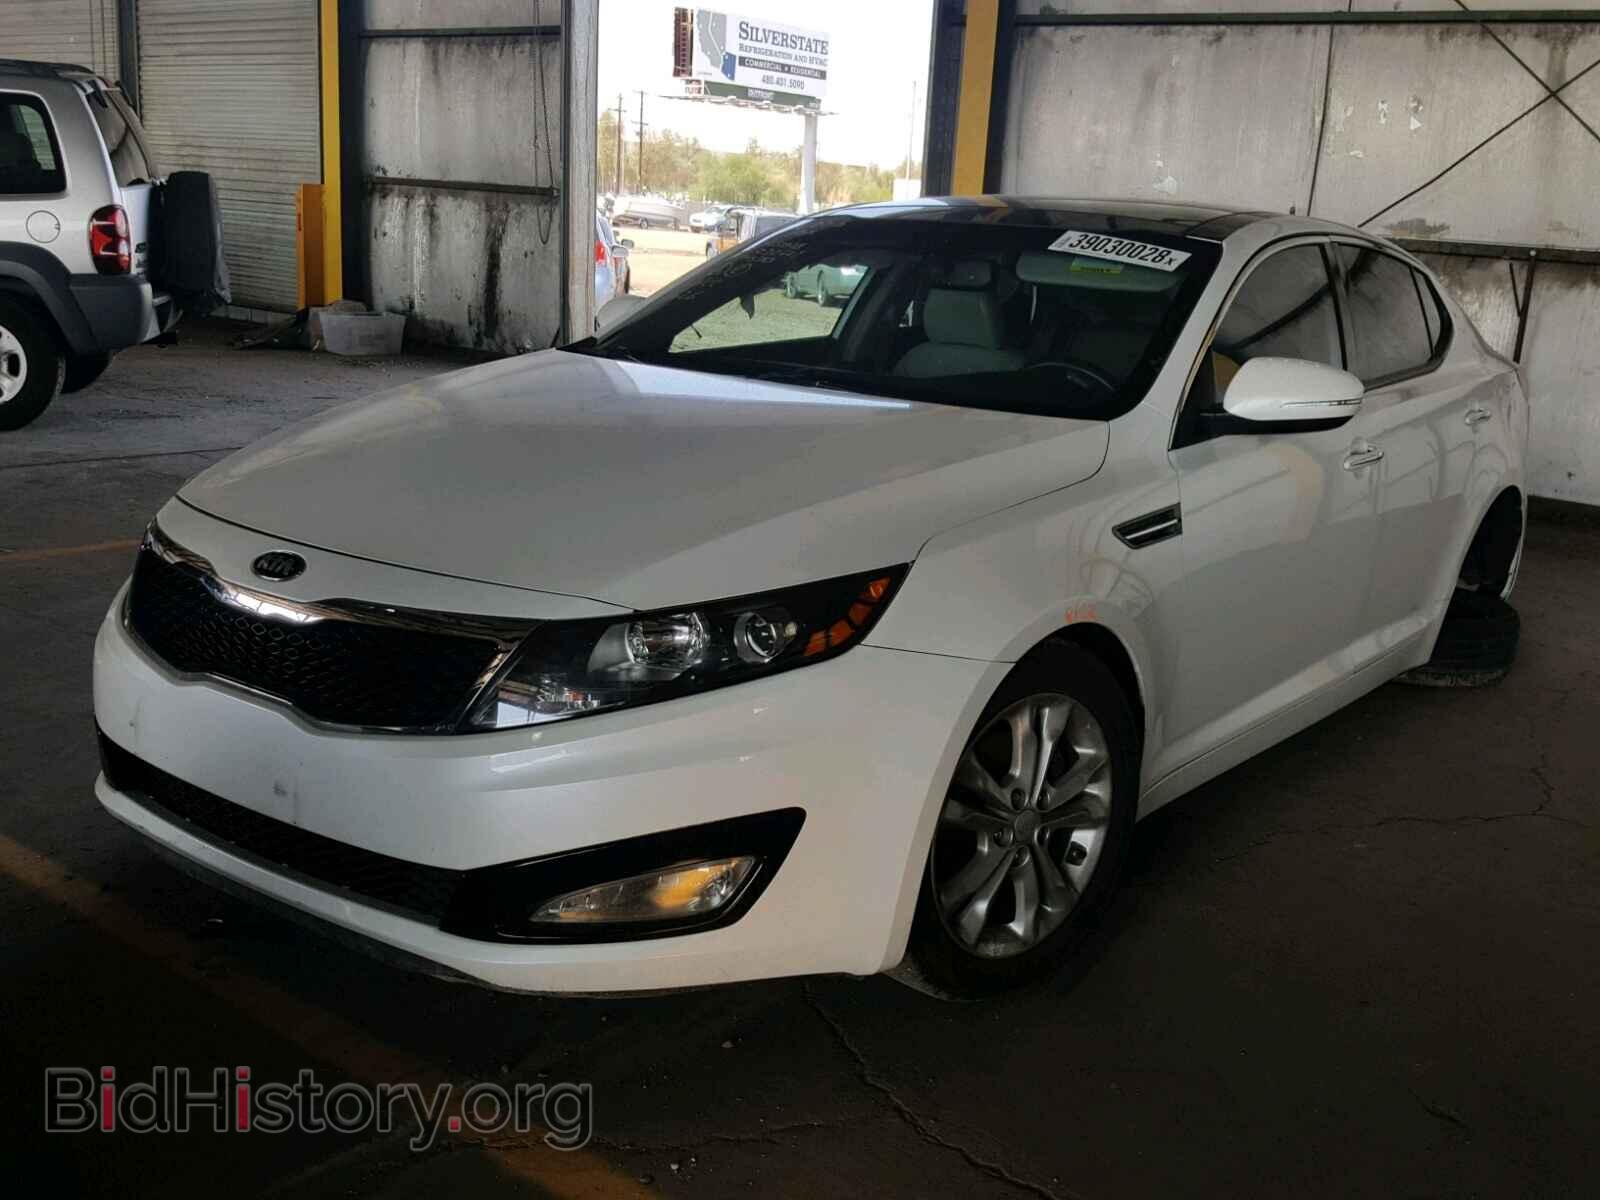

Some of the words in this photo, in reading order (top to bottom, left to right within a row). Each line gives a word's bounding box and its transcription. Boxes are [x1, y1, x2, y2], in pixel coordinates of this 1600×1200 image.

[739, 21, 829, 55] SILVERSTATE
[739, 43, 793, 60] REFRIGERATION
[793, 54, 808, 63] AND
[744, 58, 782, 71] COMMERCIAL
